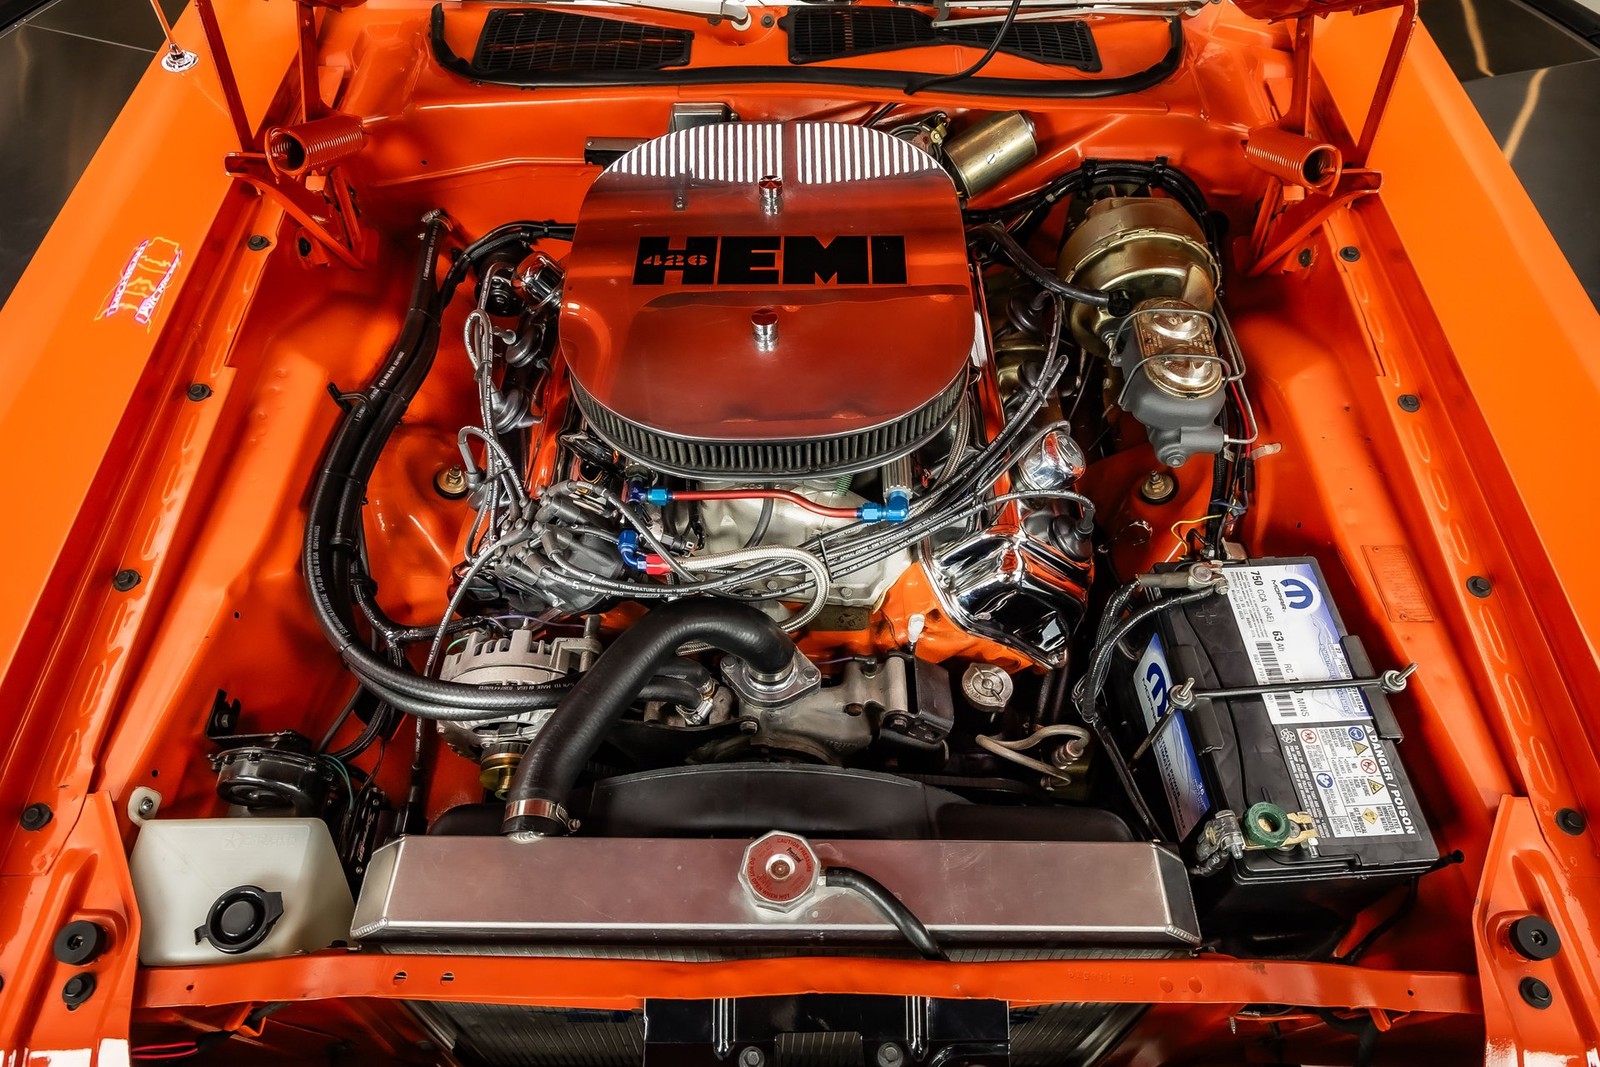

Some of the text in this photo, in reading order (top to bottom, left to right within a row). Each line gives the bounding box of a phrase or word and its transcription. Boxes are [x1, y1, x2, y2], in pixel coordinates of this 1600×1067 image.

[632, 235, 908, 285] HEMI
[642, 254, 708, 266] 426
[572, 580, 579, 590] 5
[588, 573, 596, 583] 7
[1250, 570, 1264, 585] 750
[619, 583, 655, 592] TEMPERATURE
[1256, 589, 1268, 602] CCA
[1271, 579, 1287, 610] MOPAR
[1260, 605, 1275, 622] (SAE)
[1271, 630, 1284, 641] 63
[1276, 643, 1285, 651] Ah
[1283, 663, 1294, 673] RC
[1296, 697, 1309, 716] MINS
[1169, 767, 1181, 798] POWER
[1352, 778, 1361, 788] ACID
[1358, 778, 1370, 796] SULFURIC
[1368, 735, 1394, 780] DANGER
[1390, 789, 1415, 834] POISON
[1166, 771, 1187, 831] PERFORMANCE
[1352, 807, 1368, 833] GET MEDICAL
[1375, 806, 1384, 816] WITH
[1380, 805, 1396, 832] IMMEDIATELY
[1386, 805, 1400, 828] FLUSH EYES
[1348, 812, 1361, 832] HELP FAST
[777, 838, 811, 872] CAUTION PRESSURE
[752, 877, 763, 891] OPEN
[762, 890, 778, 899] WHEN
